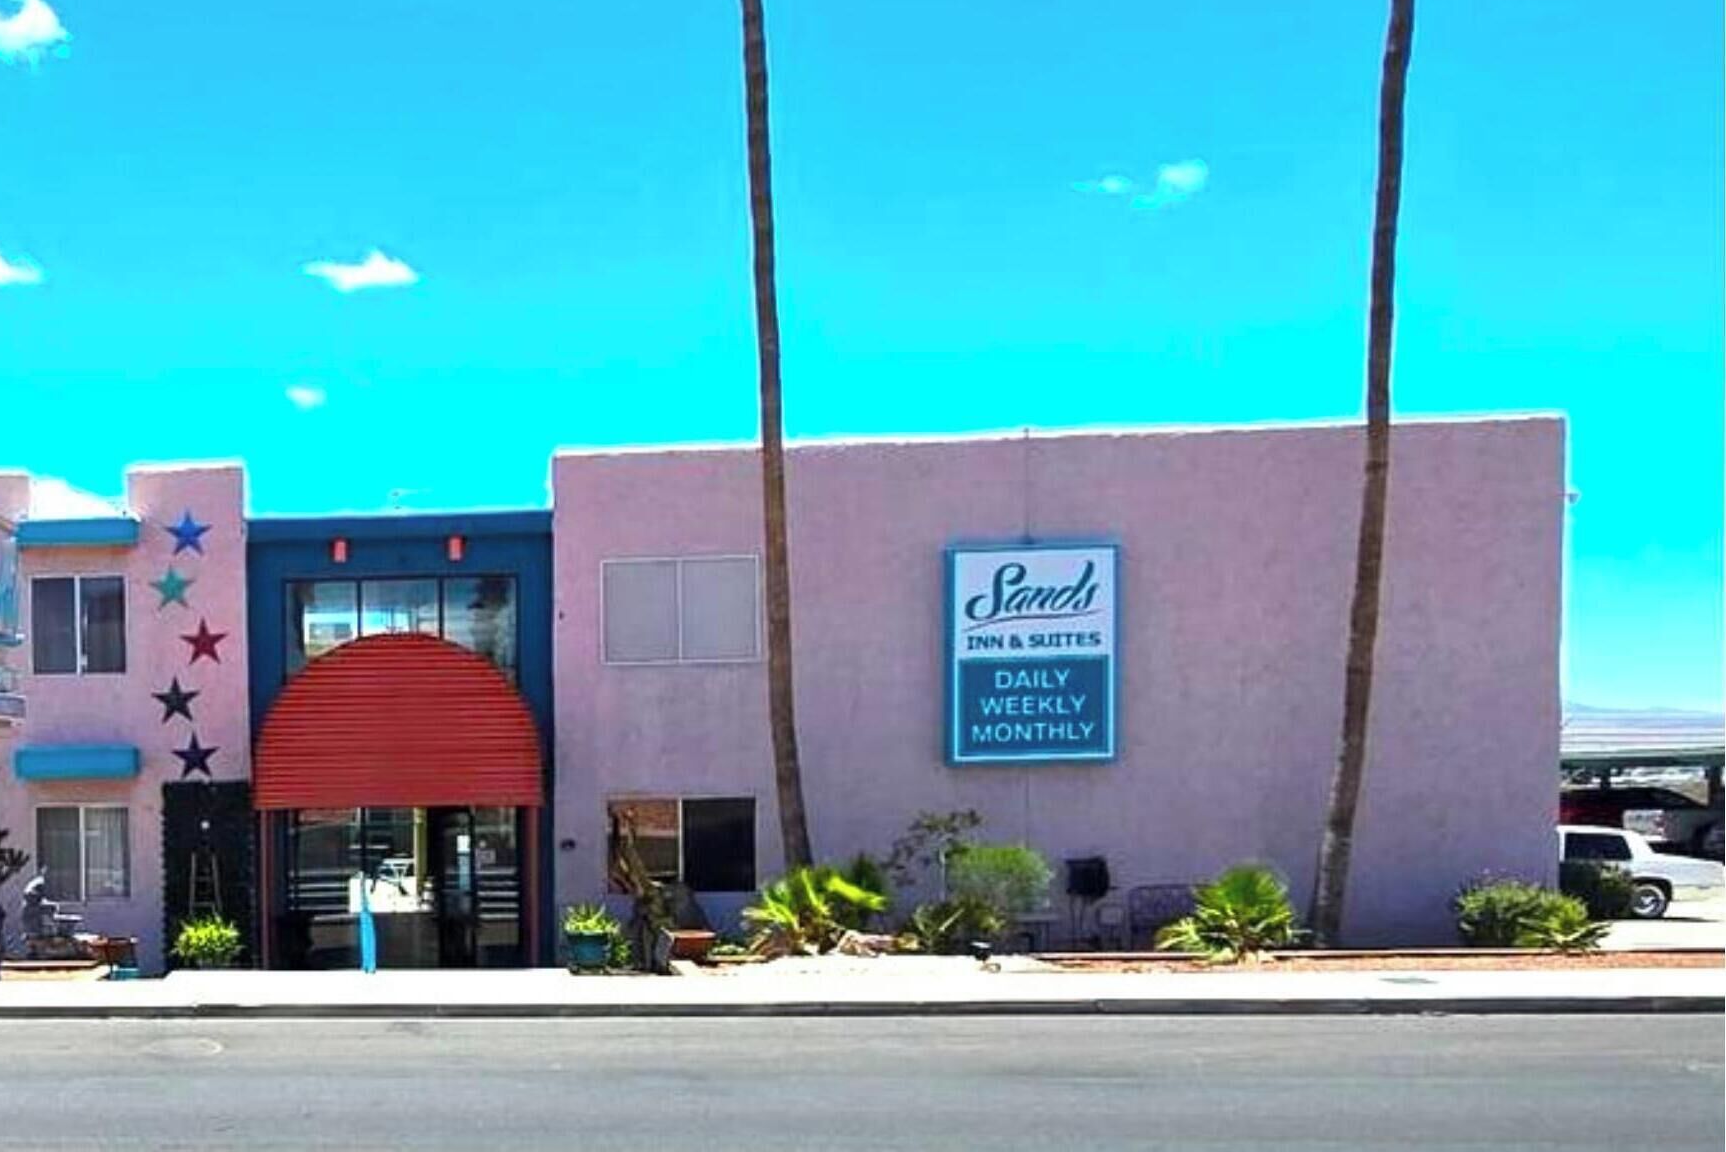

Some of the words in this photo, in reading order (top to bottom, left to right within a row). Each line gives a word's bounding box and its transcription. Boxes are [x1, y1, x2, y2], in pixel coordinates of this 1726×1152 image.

[965, 560, 1100, 621] Sands
[967, 635, 1004, 650] INN
[1008, 635, 1022, 649] &
[1028, 631, 1101, 649] SUITES
[995, 669, 1070, 689] DAILY
[980, 695, 1086, 716] WEEKLY
[971, 722, 1094, 742] MONTHLY
